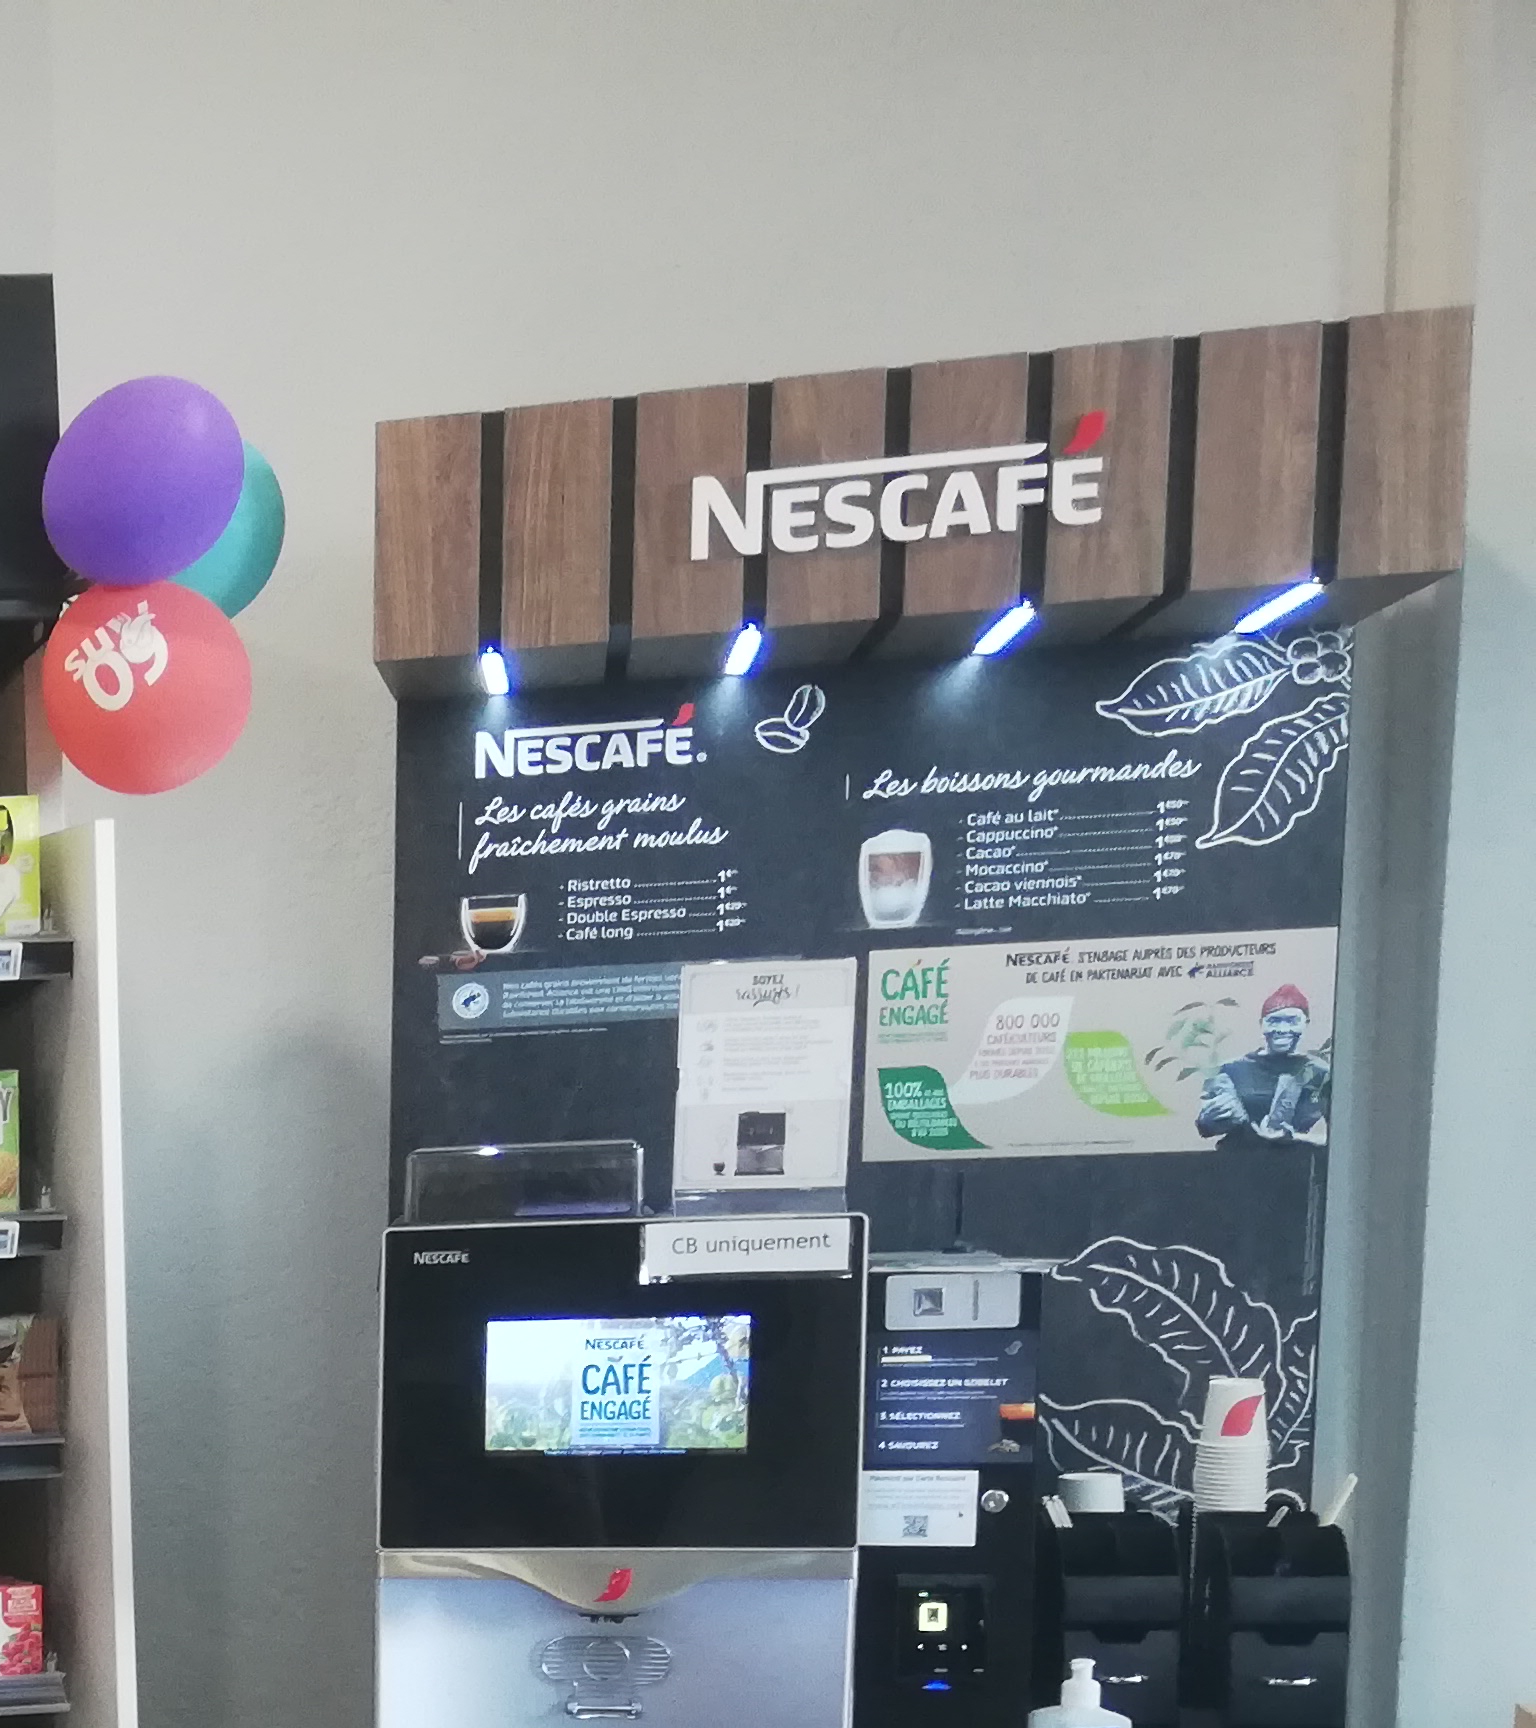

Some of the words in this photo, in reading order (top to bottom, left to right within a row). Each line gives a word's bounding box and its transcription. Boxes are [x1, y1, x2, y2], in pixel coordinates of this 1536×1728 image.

[690, 411, 1107, 560] NESCAFÉ
[862, 769, 916, 800] Les
[920, 765, 1029, 796] boissons
[1027, 748, 1203, 803] gourmandes
[474, 796, 525, 826] Les
[529, 790, 597, 833] cafés
[597, 794, 686, 829] grains
[966, 808, 1003, 827] Café
[1004, 810, 1025, 824] au
[468, 828, 628, 874] fraîchement
[632, 817, 730, 850] moulus
[567, 877, 632, 892] Ristretto
[963, 878, 1010, 894] Cacao
[566, 894, 632, 909] Espresso
[963, 894, 1004, 912] Latte
[566, 910, 618, 925] Double
[621, 906, 687, 922] Espresso
[565, 925, 598, 941] Café
[600, 925, 634, 941] long
[1005, 946, 1070, 968] NESCAFÉ
[1176, 946, 1197, 960] DES
[879, 957, 951, 1002] CAFÉ
[1041, 967, 1066, 984] CAFÉ
[879, 998, 950, 1028] ENGAGÉ
[995, 1014, 1025, 1031] 800
[1029, 1012, 1061, 1029] 000
[884, 1080, 923, 1099] 100%
[671, 1236, 699, 1256] CB
[704, 1231, 832, 1255] uniquement
[584, 1335, 646, 1351] NESCAFÉ
[580, 1355, 653, 1396] CAFÉ
[580, 1395, 653, 1421] ENGAGÉ
